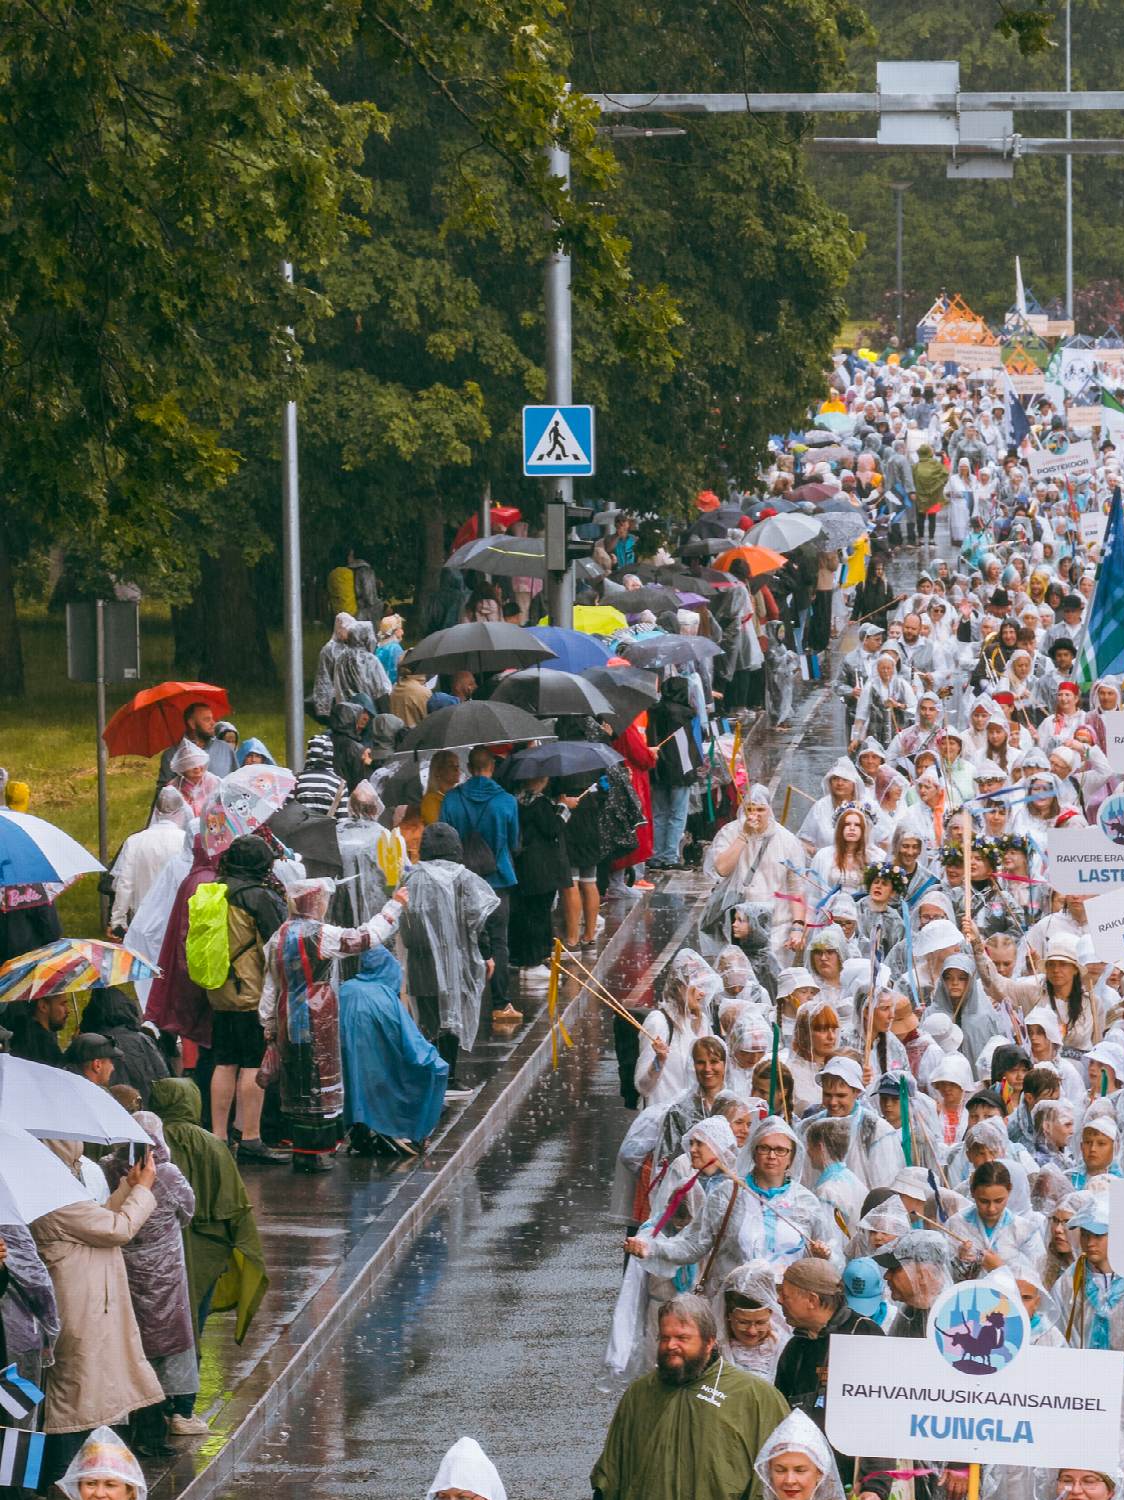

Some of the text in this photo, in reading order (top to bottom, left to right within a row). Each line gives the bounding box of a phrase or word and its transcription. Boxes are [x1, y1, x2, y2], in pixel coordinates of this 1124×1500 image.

[1056, 854, 1103, 863] RAKVERE
[841, 1383, 1107, 1412] RAHVAMUUSIKAANSAMBEL
[909, 1414, 1035, 1444] KUNGLA
